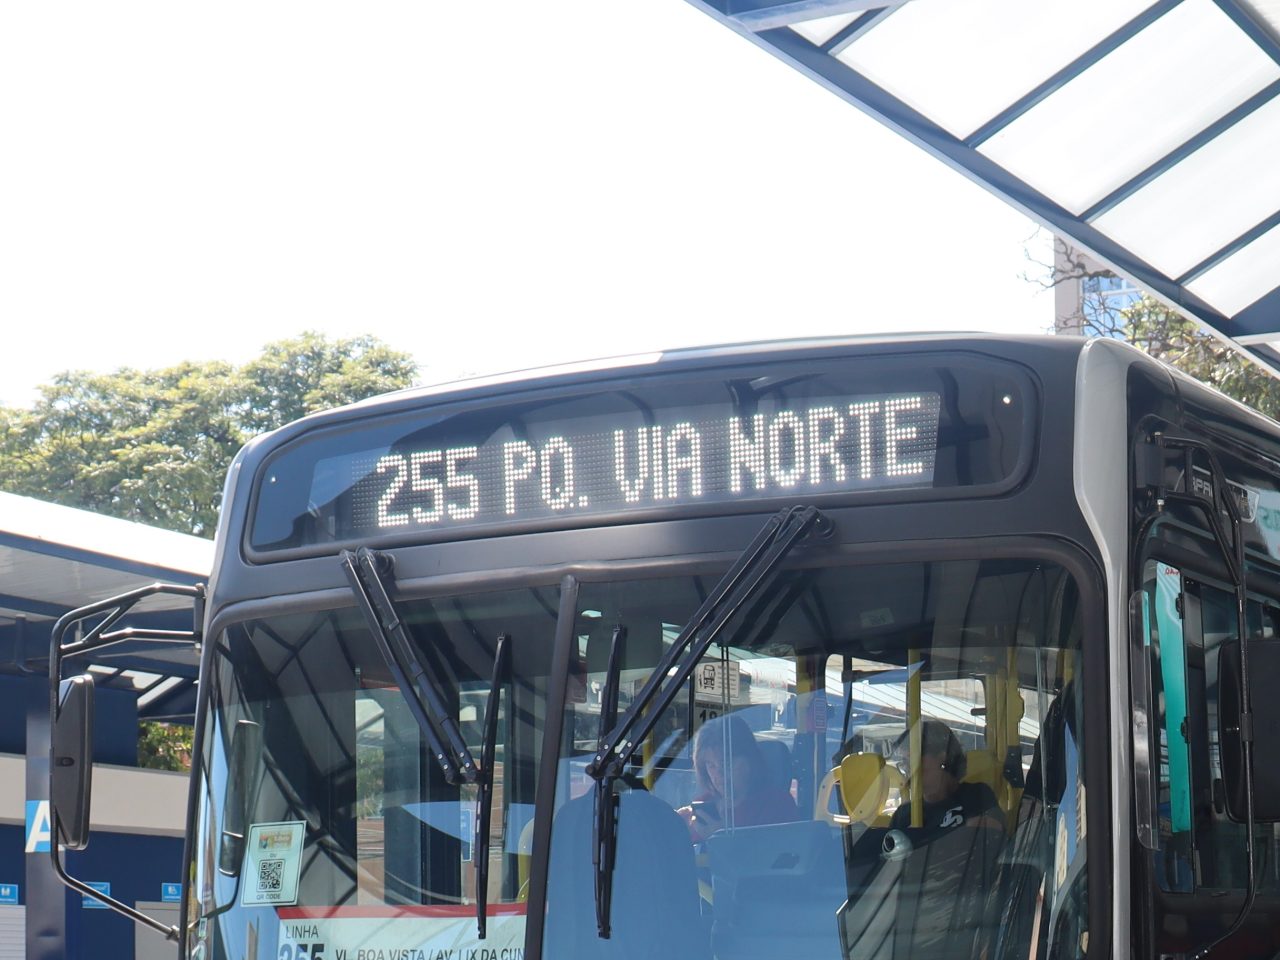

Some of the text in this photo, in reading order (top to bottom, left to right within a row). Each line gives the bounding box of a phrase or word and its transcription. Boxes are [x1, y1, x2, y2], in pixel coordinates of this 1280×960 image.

[377, 397, 923, 527] 255 PQ. VIA NORTE
[286, 925, 319, 939] LINHA
